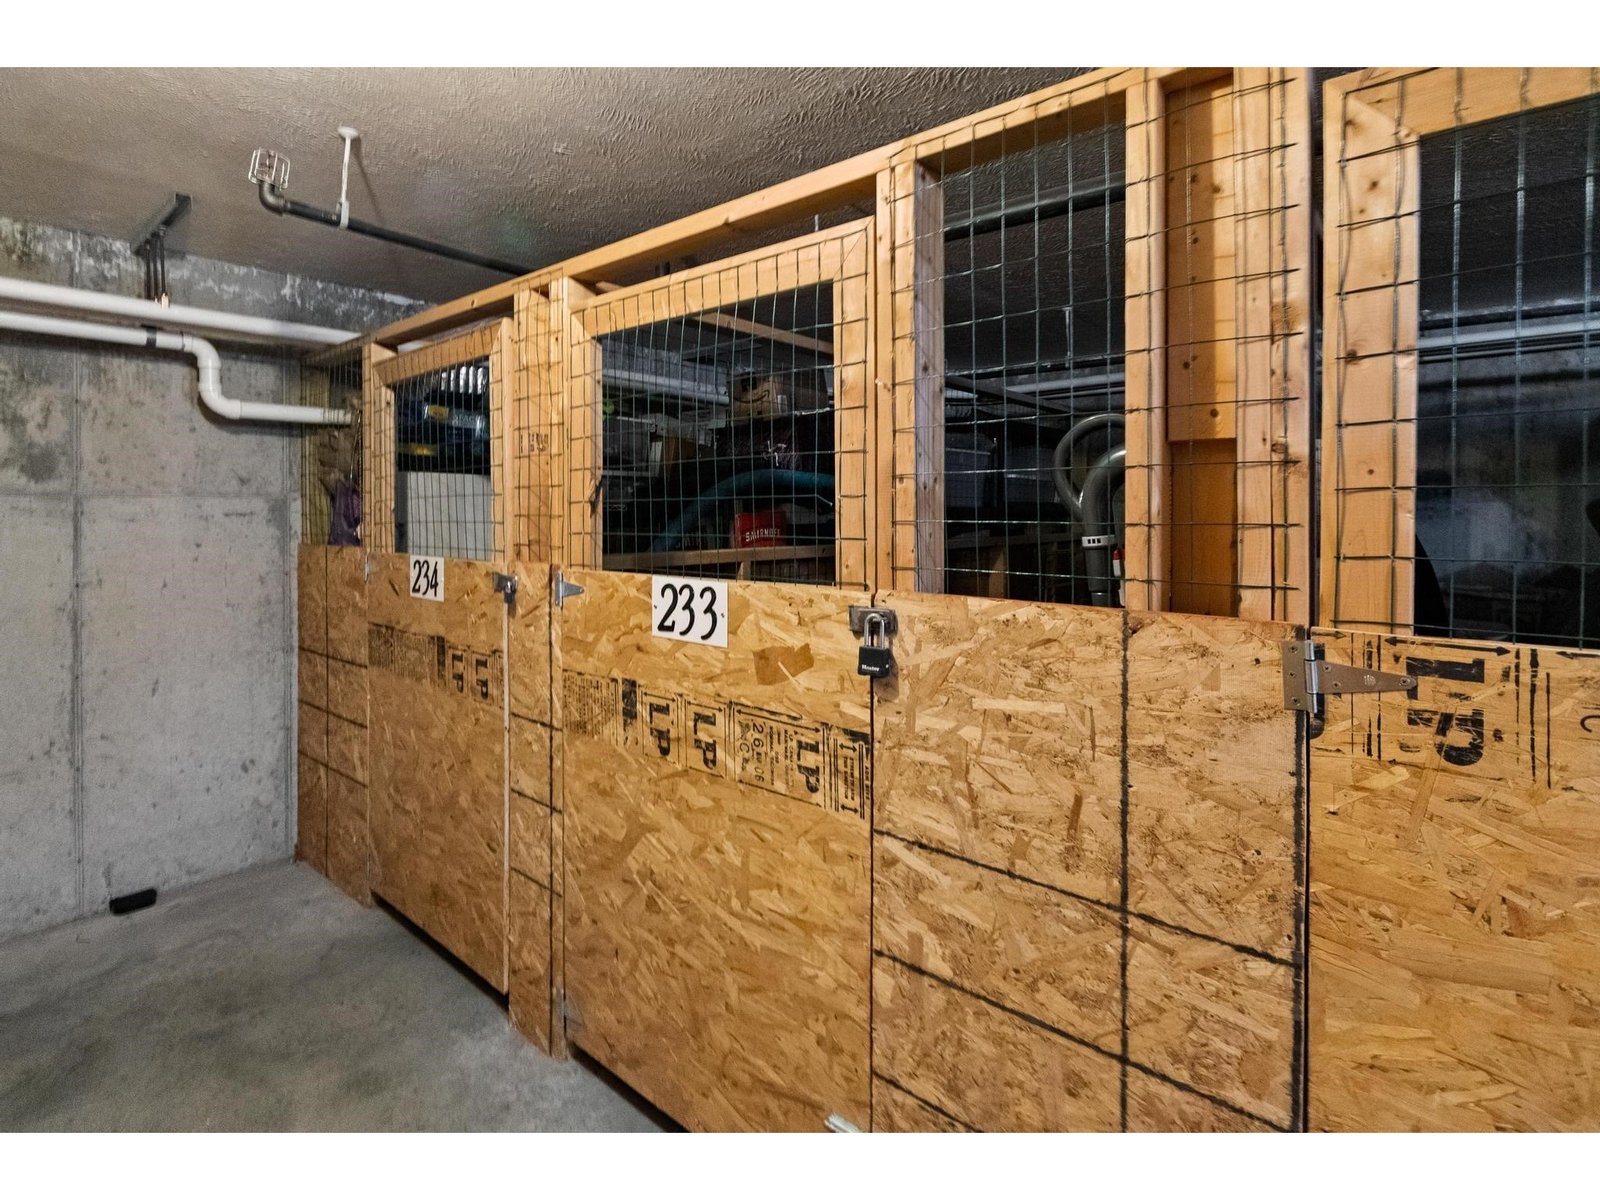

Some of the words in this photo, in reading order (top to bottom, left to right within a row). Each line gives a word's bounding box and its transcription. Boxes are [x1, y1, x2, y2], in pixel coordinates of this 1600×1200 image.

[412, 560, 438, 597] 234
[657, 583, 718, 640] 233
[452, 653, 463, 693] LP
[475, 658, 488, 700] LP
[649, 702, 670, 756] LP
[1406, 656, 1485, 766] LP
[694, 712, 717, 770] LP
[797, 740, 820, 793] LP
